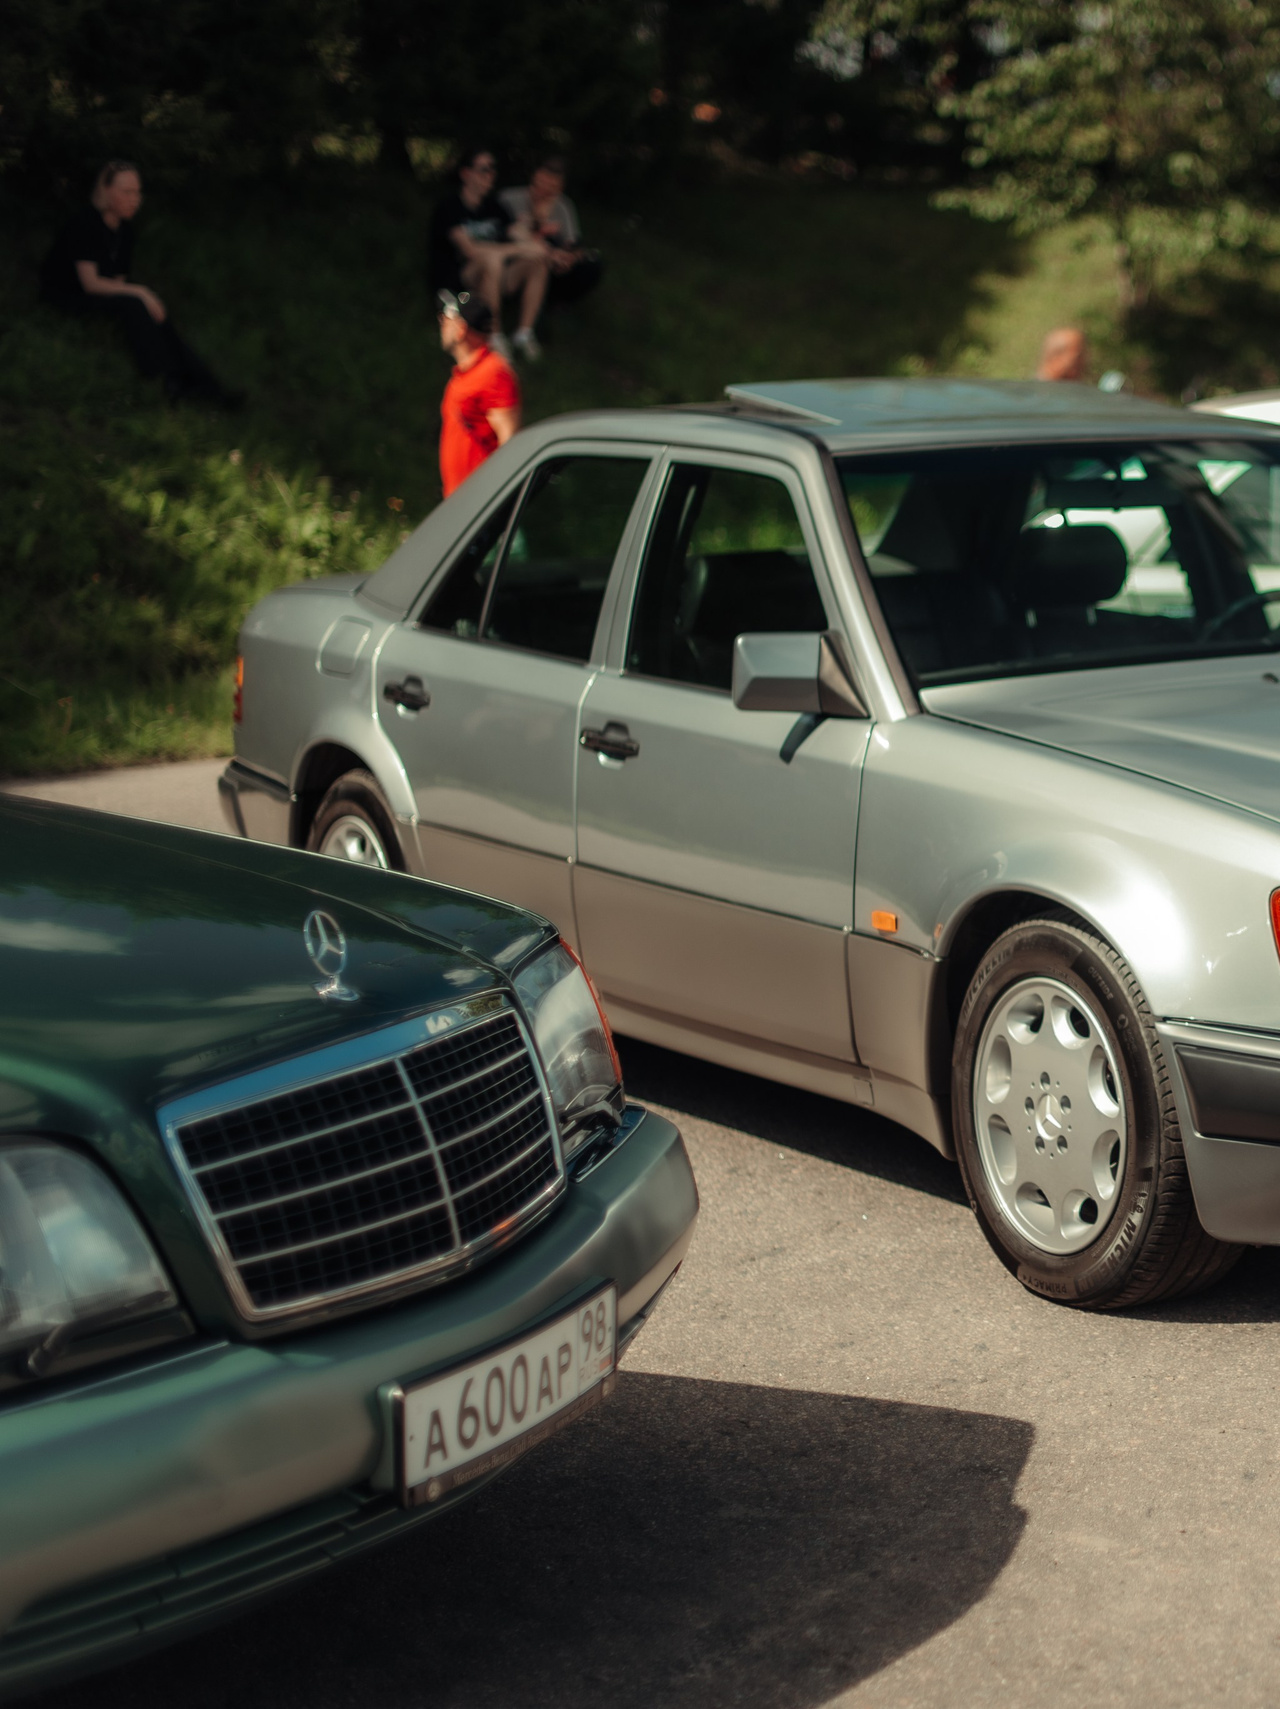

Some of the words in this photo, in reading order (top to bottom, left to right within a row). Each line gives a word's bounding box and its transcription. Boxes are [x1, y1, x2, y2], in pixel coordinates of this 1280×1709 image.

[962, 947, 1012, 1020] MICHELIN
[1087, 966, 1114, 1000] OUTSIDE
[1027, 1276, 1067, 1294] PRIMACY
[1078, 1217, 1137, 1294] MICHELIN
[582, 1301, 606, 1362] 98
